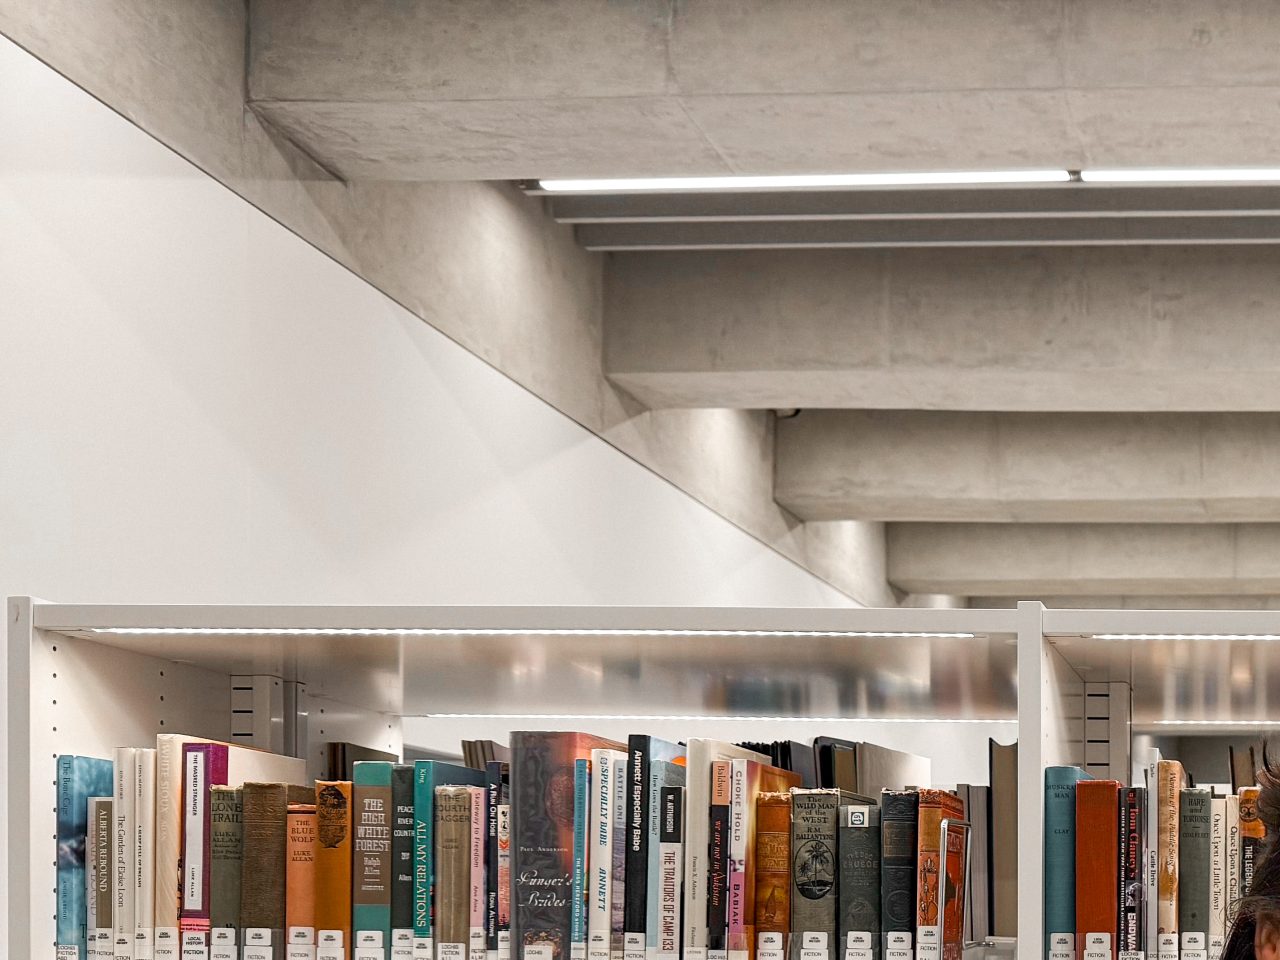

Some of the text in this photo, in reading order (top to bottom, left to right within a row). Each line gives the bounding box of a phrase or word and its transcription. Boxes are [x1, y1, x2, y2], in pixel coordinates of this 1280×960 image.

[211, 803, 242, 812] LONE
[363, 799, 383, 811] THE
[633, 751, 642, 851] Annett/Especially Babe
[212, 814, 242, 823] TRAIL
[361, 813, 385, 824] HIGH
[357, 827, 389, 838] WHITE
[416, 820, 426, 842] ALL
[100, 809, 108, 892] ALBERTA REBOUND
[356, 840, 391, 851] FOREST
[1129, 808, 1139, 879] Tom Clancy's
[416, 844, 426, 863] MY
[515, 869, 573, 886] Hunger's
[417, 862, 426, 927] RELATIONS
[528, 891, 566, 907] Brides
[598, 868, 607, 912] ANNETT
[662, 851, 675, 951] THE TRAITORS OF CAMP 133
